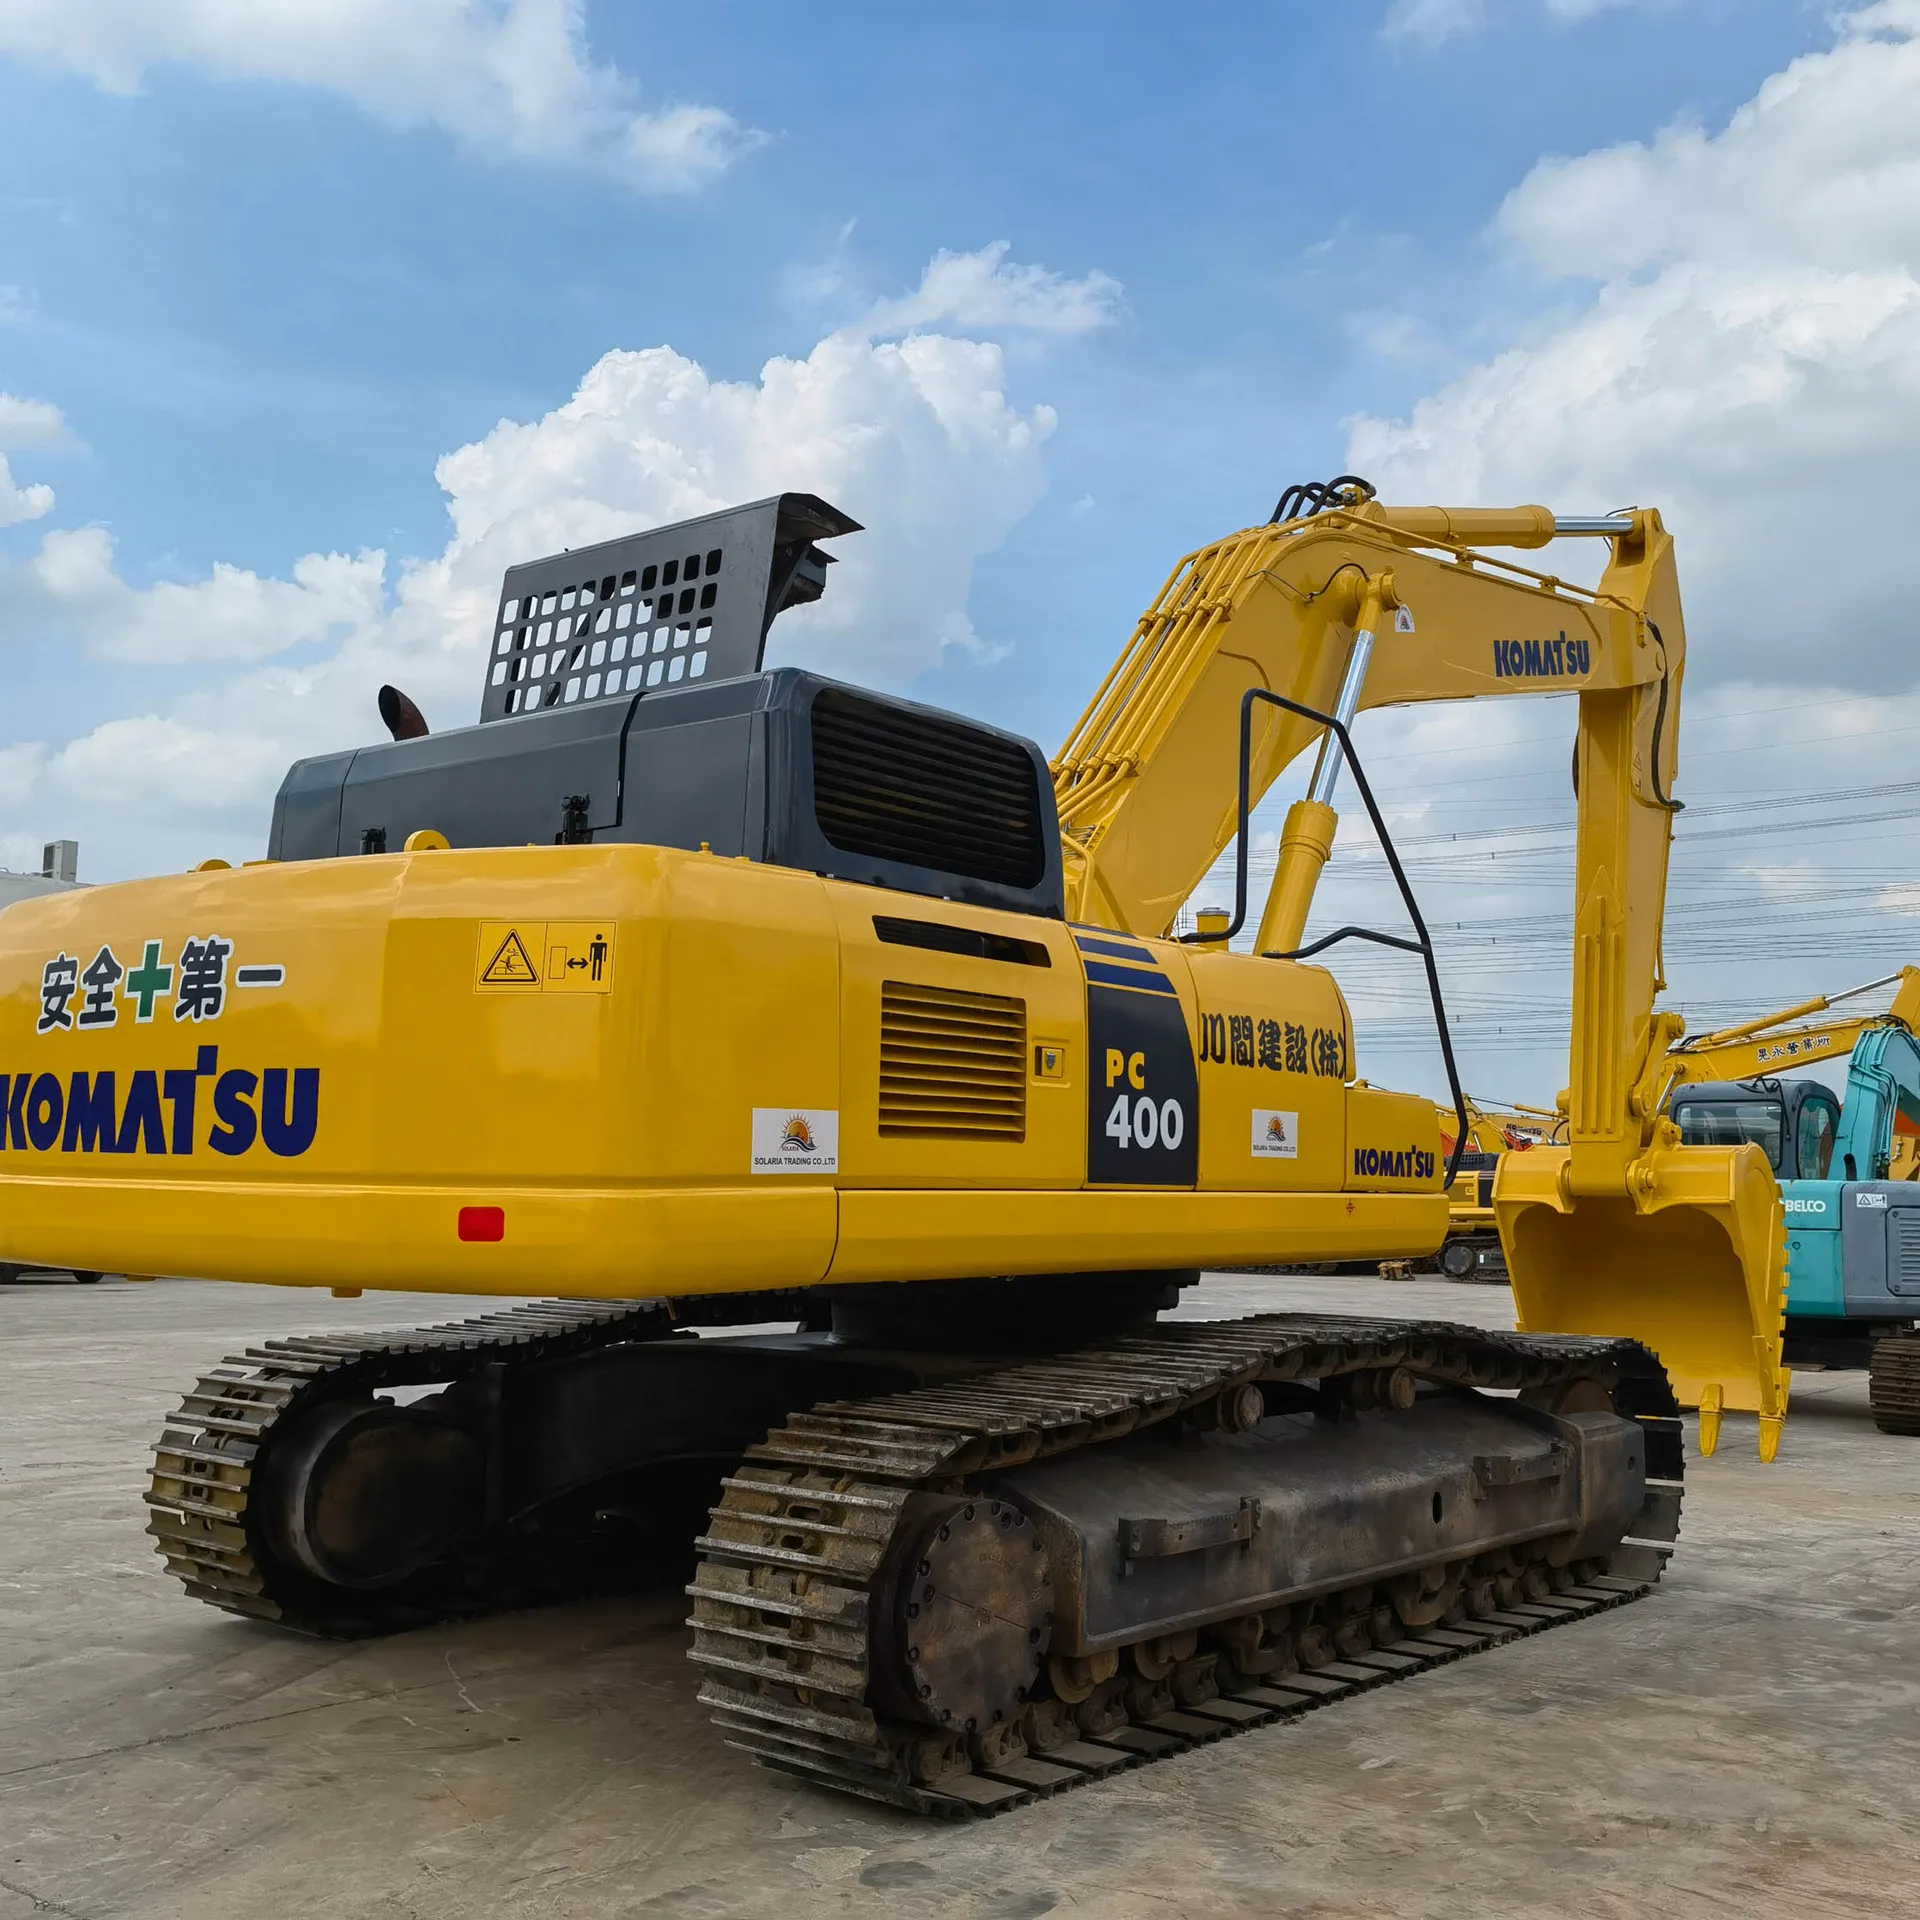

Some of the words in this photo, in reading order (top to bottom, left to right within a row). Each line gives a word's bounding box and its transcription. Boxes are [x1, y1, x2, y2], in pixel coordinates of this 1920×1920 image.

[1493, 631, 1590, 677] KOMATSU
[1106, 1048, 1146, 1090] PC
[0, 1045, 320, 1156] KOMATSU
[1105, 1094, 1184, 1150] 400
[754, 1157, 783, 1165] SOLARIA
[784, 1157, 811, 1165] TRADING
[1354, 1145, 1435, 1178] KOMATSU
[1779, 1198, 1827, 1213] BELCO
